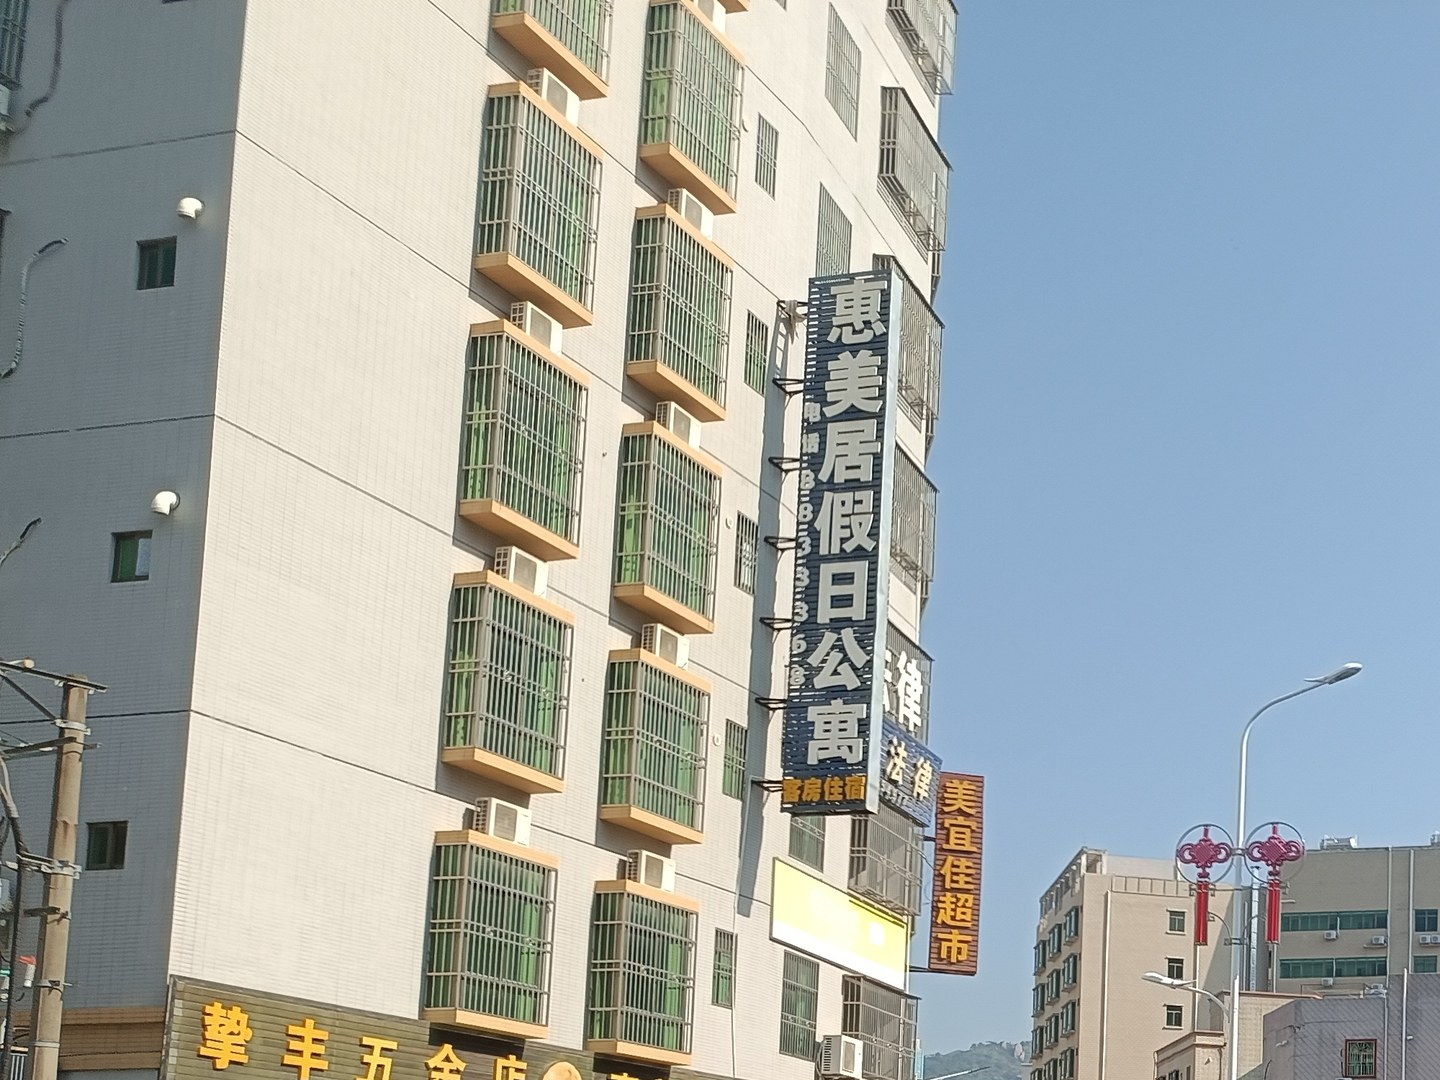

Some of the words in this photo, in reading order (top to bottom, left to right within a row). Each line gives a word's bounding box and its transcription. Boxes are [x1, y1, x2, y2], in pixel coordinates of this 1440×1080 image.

[806, 277, 888, 766] 惠美居假日公寓
[884, 650, 923, 732] 律
[783, 775, 866, 803] 客房住宿
[886, 735, 932, 801] 法律
[936, 779, 979, 964] 美宜佳超市
